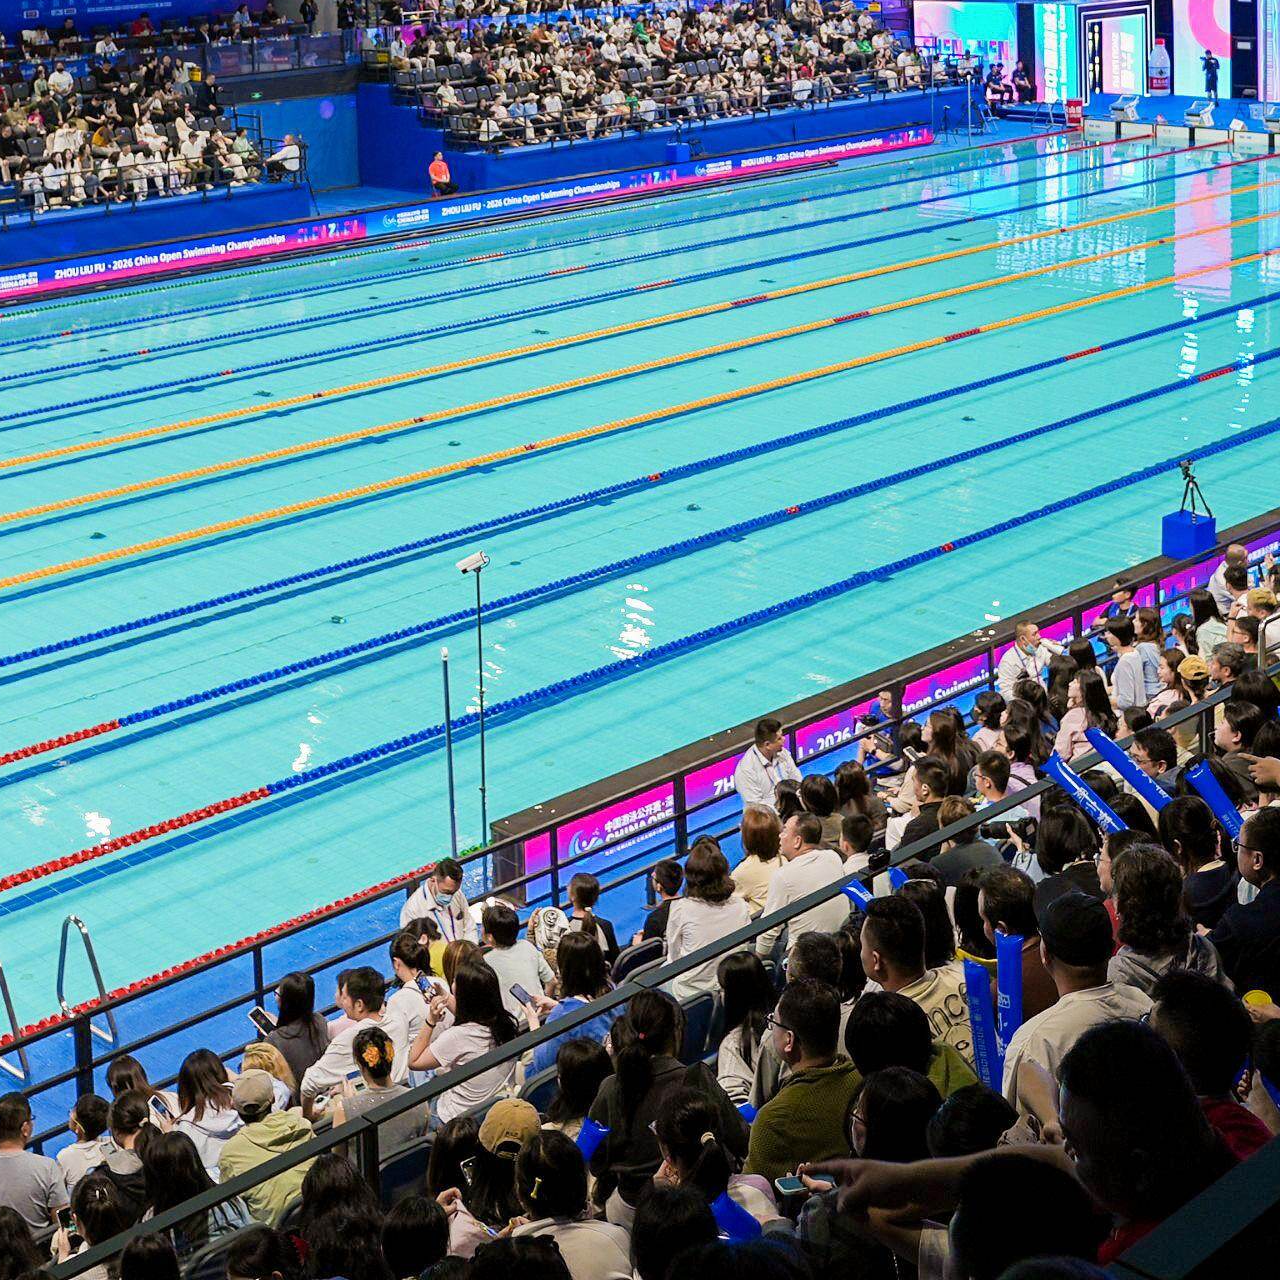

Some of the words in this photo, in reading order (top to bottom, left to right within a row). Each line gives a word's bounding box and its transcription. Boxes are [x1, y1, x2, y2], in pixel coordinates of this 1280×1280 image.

[503, 195, 522, 207] China
[522, 192, 541, 204] Open
[541, 186, 574, 201] Swimming
[574, 180, 620, 196] Championships
[54, 266, 79, 280] ZHOU
[79, 264, 93, 275] LIU
[94, 262, 106, 273] FU
[112, 256, 133, 270] 2026
[134, 254, 158, 267] China
[159, 250, 182, 263] Open
[182, 243, 226, 259] Swimming
[226, 233, 286, 252] Championships
